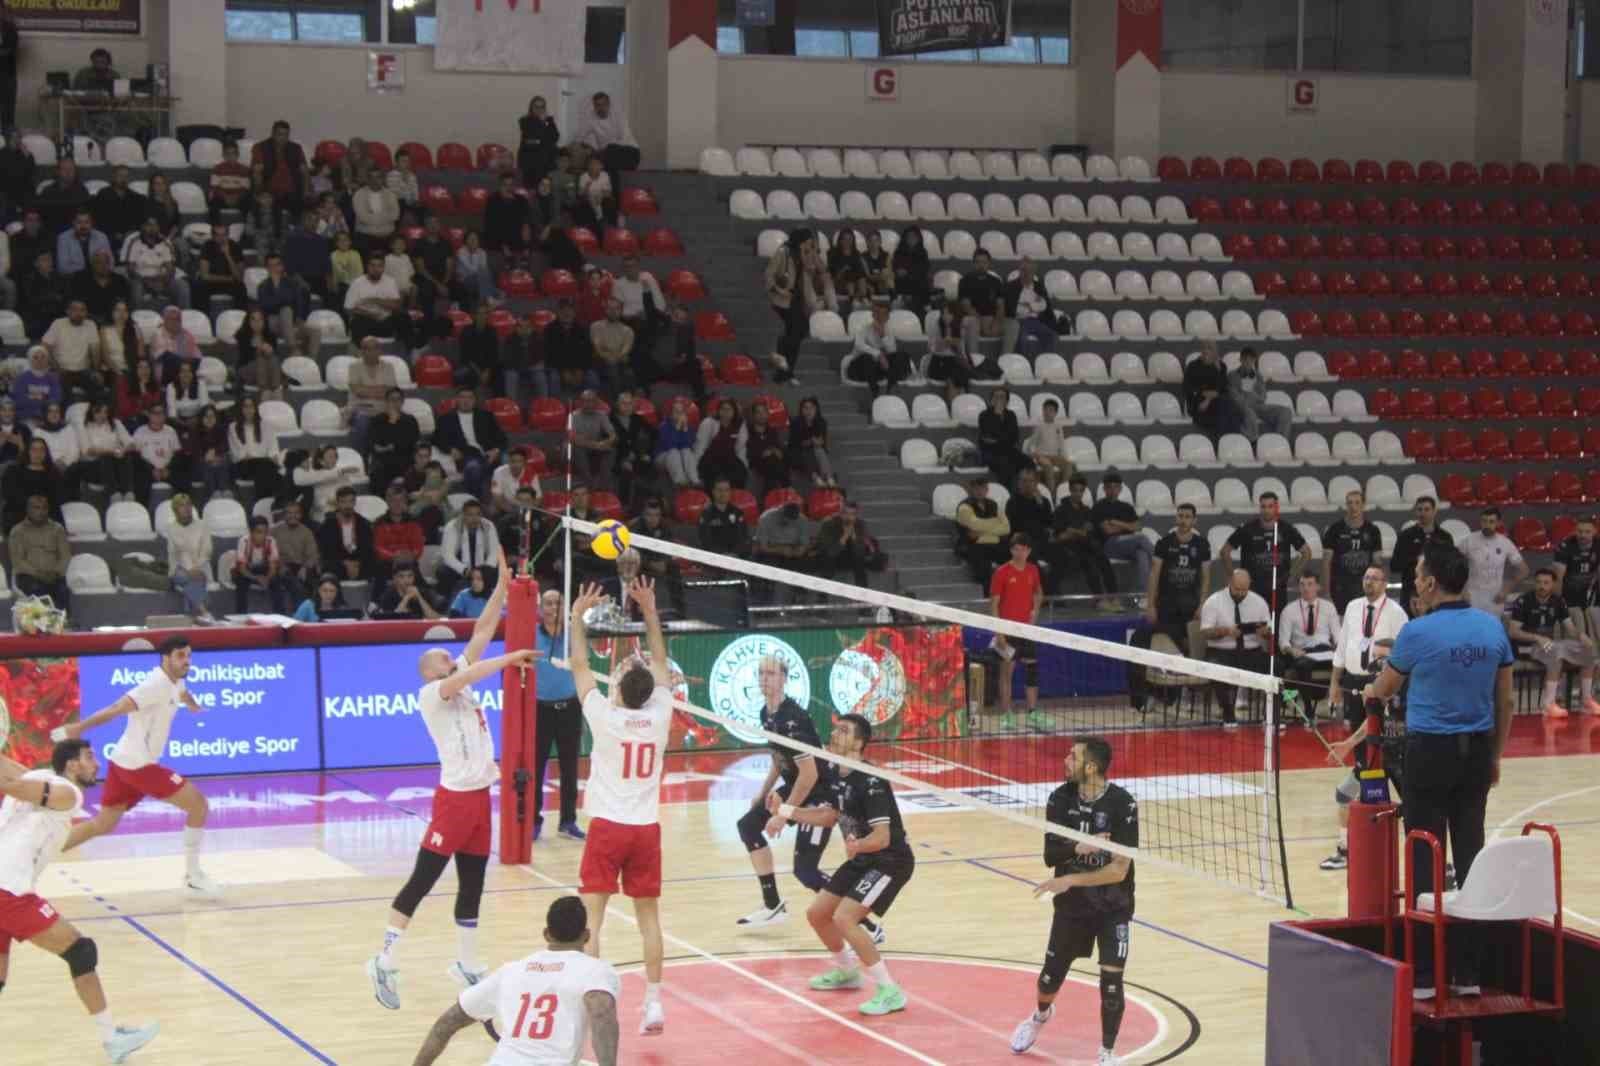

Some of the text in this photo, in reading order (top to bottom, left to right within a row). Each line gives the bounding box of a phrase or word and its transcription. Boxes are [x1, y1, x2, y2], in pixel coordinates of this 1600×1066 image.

[897, 7, 992, 32] ASLANLARI
[377, 54, 396, 81] F
[874, 69, 896, 94] G
[1295, 80, 1314, 104] G
[187, 663, 285, 684] Onikişubat
[221, 688, 265, 708] Spor
[169, 736, 299, 760] Belediye Spor
[621, 742, 655, 779] 10
[856, 880, 871, 894] 12
[1117, 941, 1127, 958] 11
[512, 993, 558, 1039] 13
